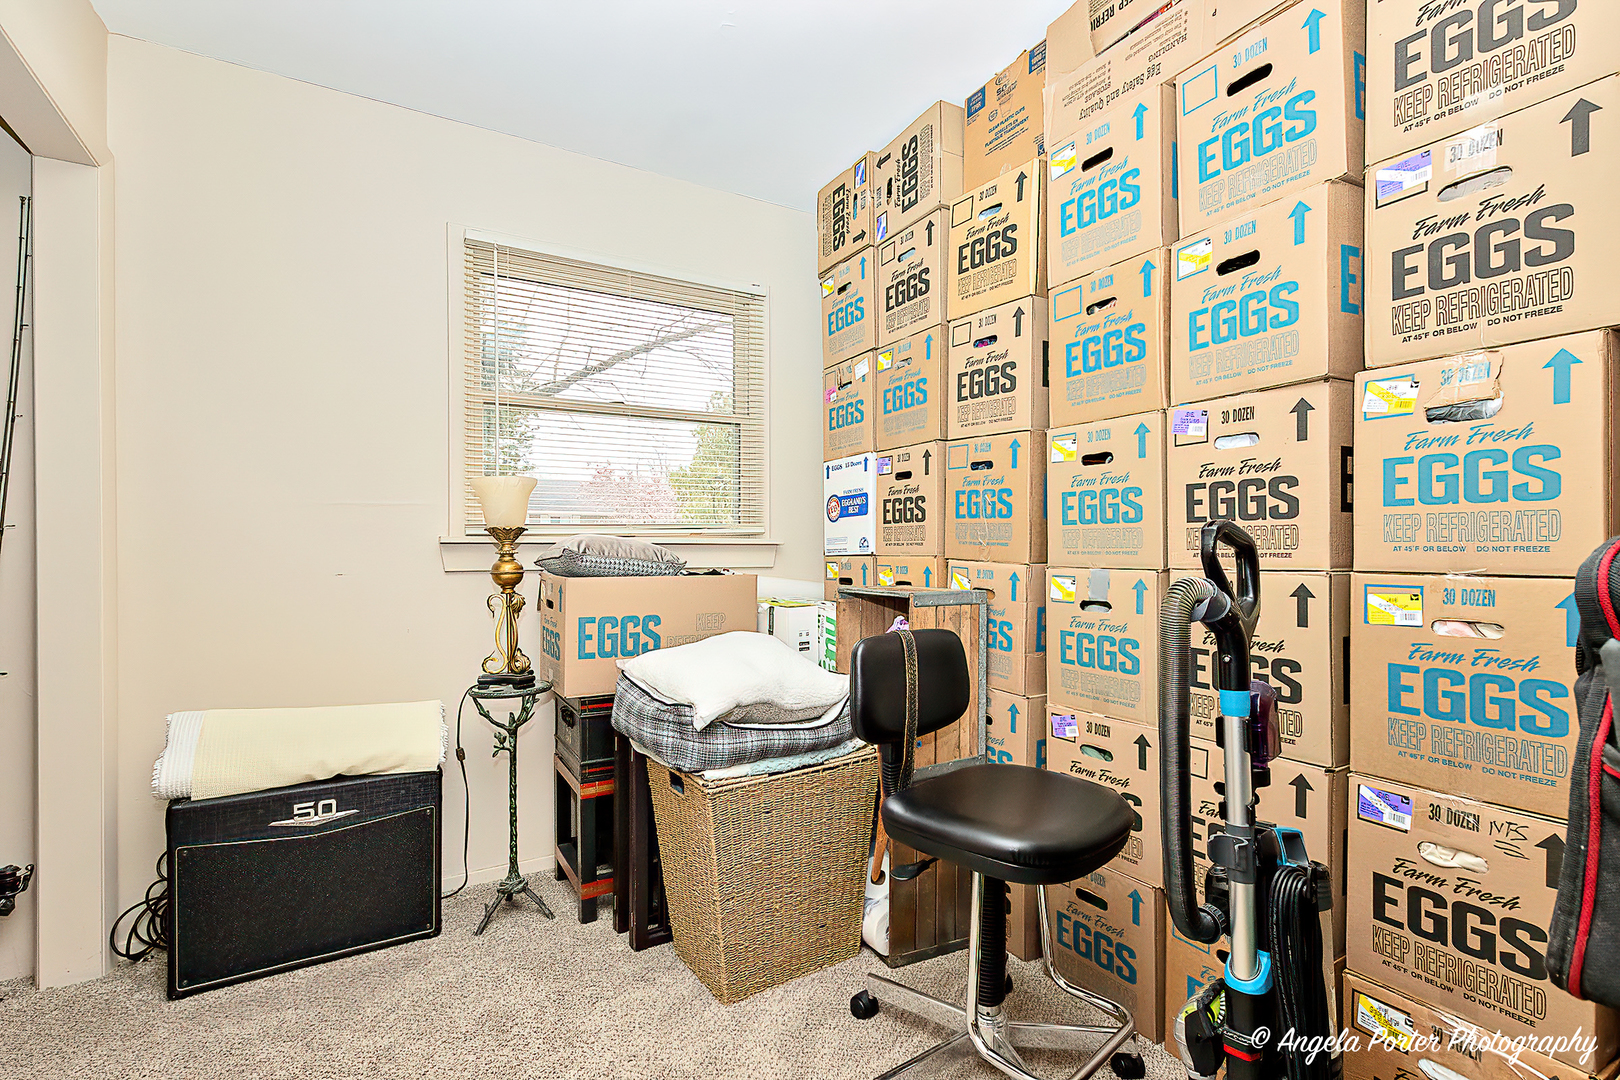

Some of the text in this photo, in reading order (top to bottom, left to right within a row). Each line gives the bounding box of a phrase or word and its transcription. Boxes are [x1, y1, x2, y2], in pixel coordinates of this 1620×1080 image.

[1148, 33, 1187, 62] HANDLING
[1233, 37, 1268, 69] 30 DOZEN
[1121, 73, 1145, 94] Safety
[1147, 62, 1161, 80] Egg
[1394, 24, 1576, 127] KEEP REFRIGERATED
[1078, 98, 1104, 120] Quality
[1106, 89, 1119, 106] and
[1212, 77, 1297, 133] Farm Fresh
[1403, 124, 1413, 134] AT
[1434, 112, 1446, 122] OR
[1448, 98, 1479, 116] BELOW
[1489, 89, 1502, 100] DO
[1504, 81, 1524, 94] NOT
[1527, 64, 1565, 85] FREEZE
[1086, 122, 1110, 145] 30 DOZEN
[1198, 90, 1317, 184] EGGS
[1450, 143, 1462, 164] 30
[902, 134, 918, 214] EGGS
[1070, 176, 1096, 196] Farm
[1098, 155, 1128, 181] Fresh
[1199, 138, 1317, 212] KEEP REFRIGERATED
[833, 183, 845, 252] EGGS
[1061, 168, 1140, 238] EGGS
[1412, 184, 1546, 240] Farm Fresh
[966, 212, 1010, 240] Farm Fresh
[1224, 220, 1256, 245] 30 DOZEN
[958, 223, 1018, 275] EGGS
[1392, 203, 1575, 302] EGGS
[885, 267, 930, 313] EGGS
[1202, 265, 1282, 304] Farm Fresh
[1392, 266, 1574, 336] KEEP REFRIGERATED
[828, 296, 864, 336] EGGS
[1075, 309, 1133, 338] Farm Fresh
[1189, 281, 1299, 352] EGGS
[1402, 334, 1412, 343] AT
[1433, 328, 1444, 337] OR
[1447, 321, 1478, 334] BELOW
[1487, 316, 1501, 326] DO
[1503, 312, 1522, 323] NOT
[1525, 305, 1563, 319] FREEZE
[965, 349, 1009, 369] Farm Fresh
[1066, 323, 1146, 378] EGGS
[1189, 329, 1299, 380] KEEP REFRIGERATED
[883, 377, 927, 415] EGGS
[957, 361, 1016, 402] EGGS
[829, 399, 864, 431] EGGS
[1221, 410, 1230, 424] 30
[1233, 406, 1255, 422] DOZEN
[1087, 428, 1111, 443] 30 DOZEN
[1404, 422, 1535, 451] Farm Fresh
[962, 474, 1004, 487] Farm Fresh
[1071, 471, 1130, 488] Farm Fresh
[1199, 457, 1282, 478] Farm Fresh
[1383, 444, 1561, 507] EGGS
[883, 496, 926, 524] EGGS
[888, 486, 902, 496] Farm
[955, 488, 1013, 519] EGGS
[1062, 487, 1143, 525] EGGS
[1186, 476, 1299, 523] EGGS
[1383, 509, 1561, 542] KEEP REFRIGERATED
[1443, 588, 1496, 608] 30 DOZEN
[577, 614, 662, 660] EGGS
[696, 612, 727, 631] KEEP
[1069, 616, 1128, 634] Farm Fresh
[543, 626, 560, 661] EGGS
[1060, 630, 1140, 675] EGGS
[1408, 642, 1541, 672] Farm Fresh
[1388, 663, 1569, 738] EGGS
[1086, 721, 1092, 734] 30
[1094, 723, 1111, 738] DOZEN
[1388, 717, 1568, 779] KEEP REFRIGERATED
[1070, 761, 1130, 788] Farm Fresh
[1428, 755, 1440, 763] OR
[1442, 758, 1472, 771] BELOW
[1482, 766, 1495, 775] DO
[1497, 769, 1516, 780] NOT
[1519, 774, 1557, 787] FREEZE
[293, 799, 336, 821] 50
[1428, 802, 1441, 822] 30
[1447, 804, 1480, 833] DOZEN
[1392, 857, 1521, 911] Farm Fresh
[1066, 900, 1125, 938] Farm Fresh
[1373, 871, 1548, 981] EGGS
[1056, 910, 1137, 985] EGGS
[1372, 924, 1546, 1021] KEEP REFRIGERATED
[1411, 971, 1422, 979] OR
[1425, 975, 1454, 994] BELOW
[1463, 992, 1476, 1002] DO
[1478, 997, 1497, 1011] NOT
[1499, 1005, 1536, 1028] FREEZE
